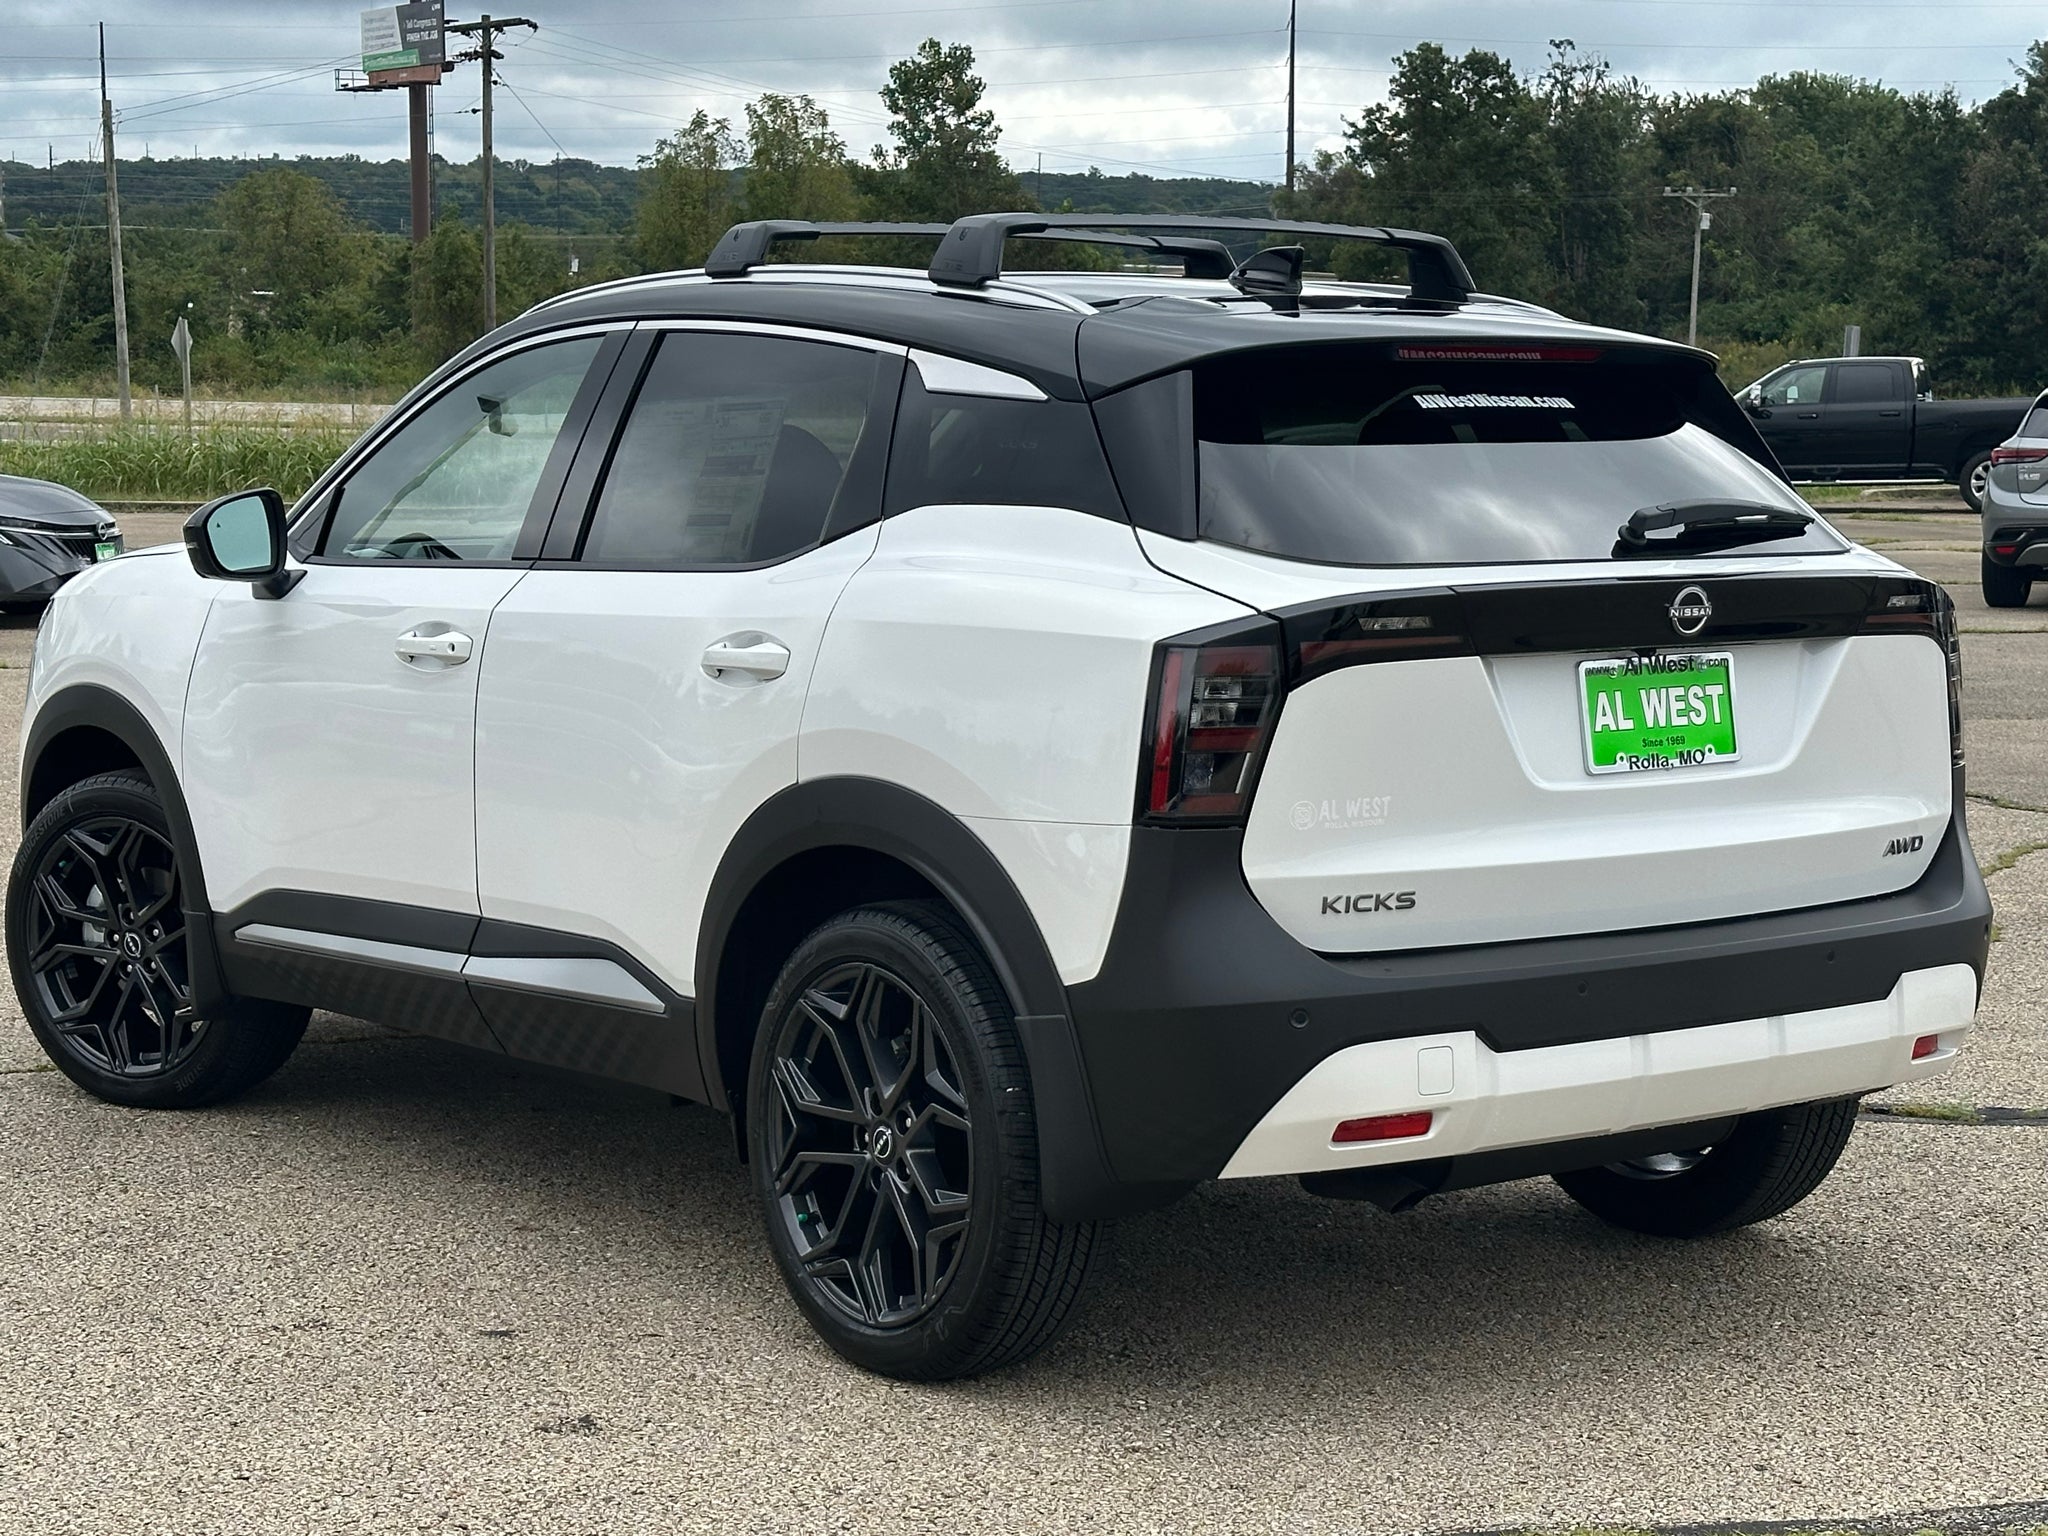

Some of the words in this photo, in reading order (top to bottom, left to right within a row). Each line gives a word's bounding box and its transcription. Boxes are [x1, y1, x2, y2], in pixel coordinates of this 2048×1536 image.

[1413, 394, 1576, 409] AlWestNissan.com
[1670, 607, 1712, 617] NISSAN
[1648, 653, 1695, 675] West
[1594, 691, 1634, 732] AL
[1640, 684, 1723, 730] WEST
[1642, 737, 1663, 748] Since
[1665, 735, 1685, 746] 1969
[1629, 753, 1674, 770] Rolla,
[1679, 749, 1705, 765] MO
[1318, 799, 1339, 821] AL
[1346, 795, 1392, 818] WEST
[1882, 835, 1923, 857] AWD
[1321, 891, 1416, 915] KICKS
